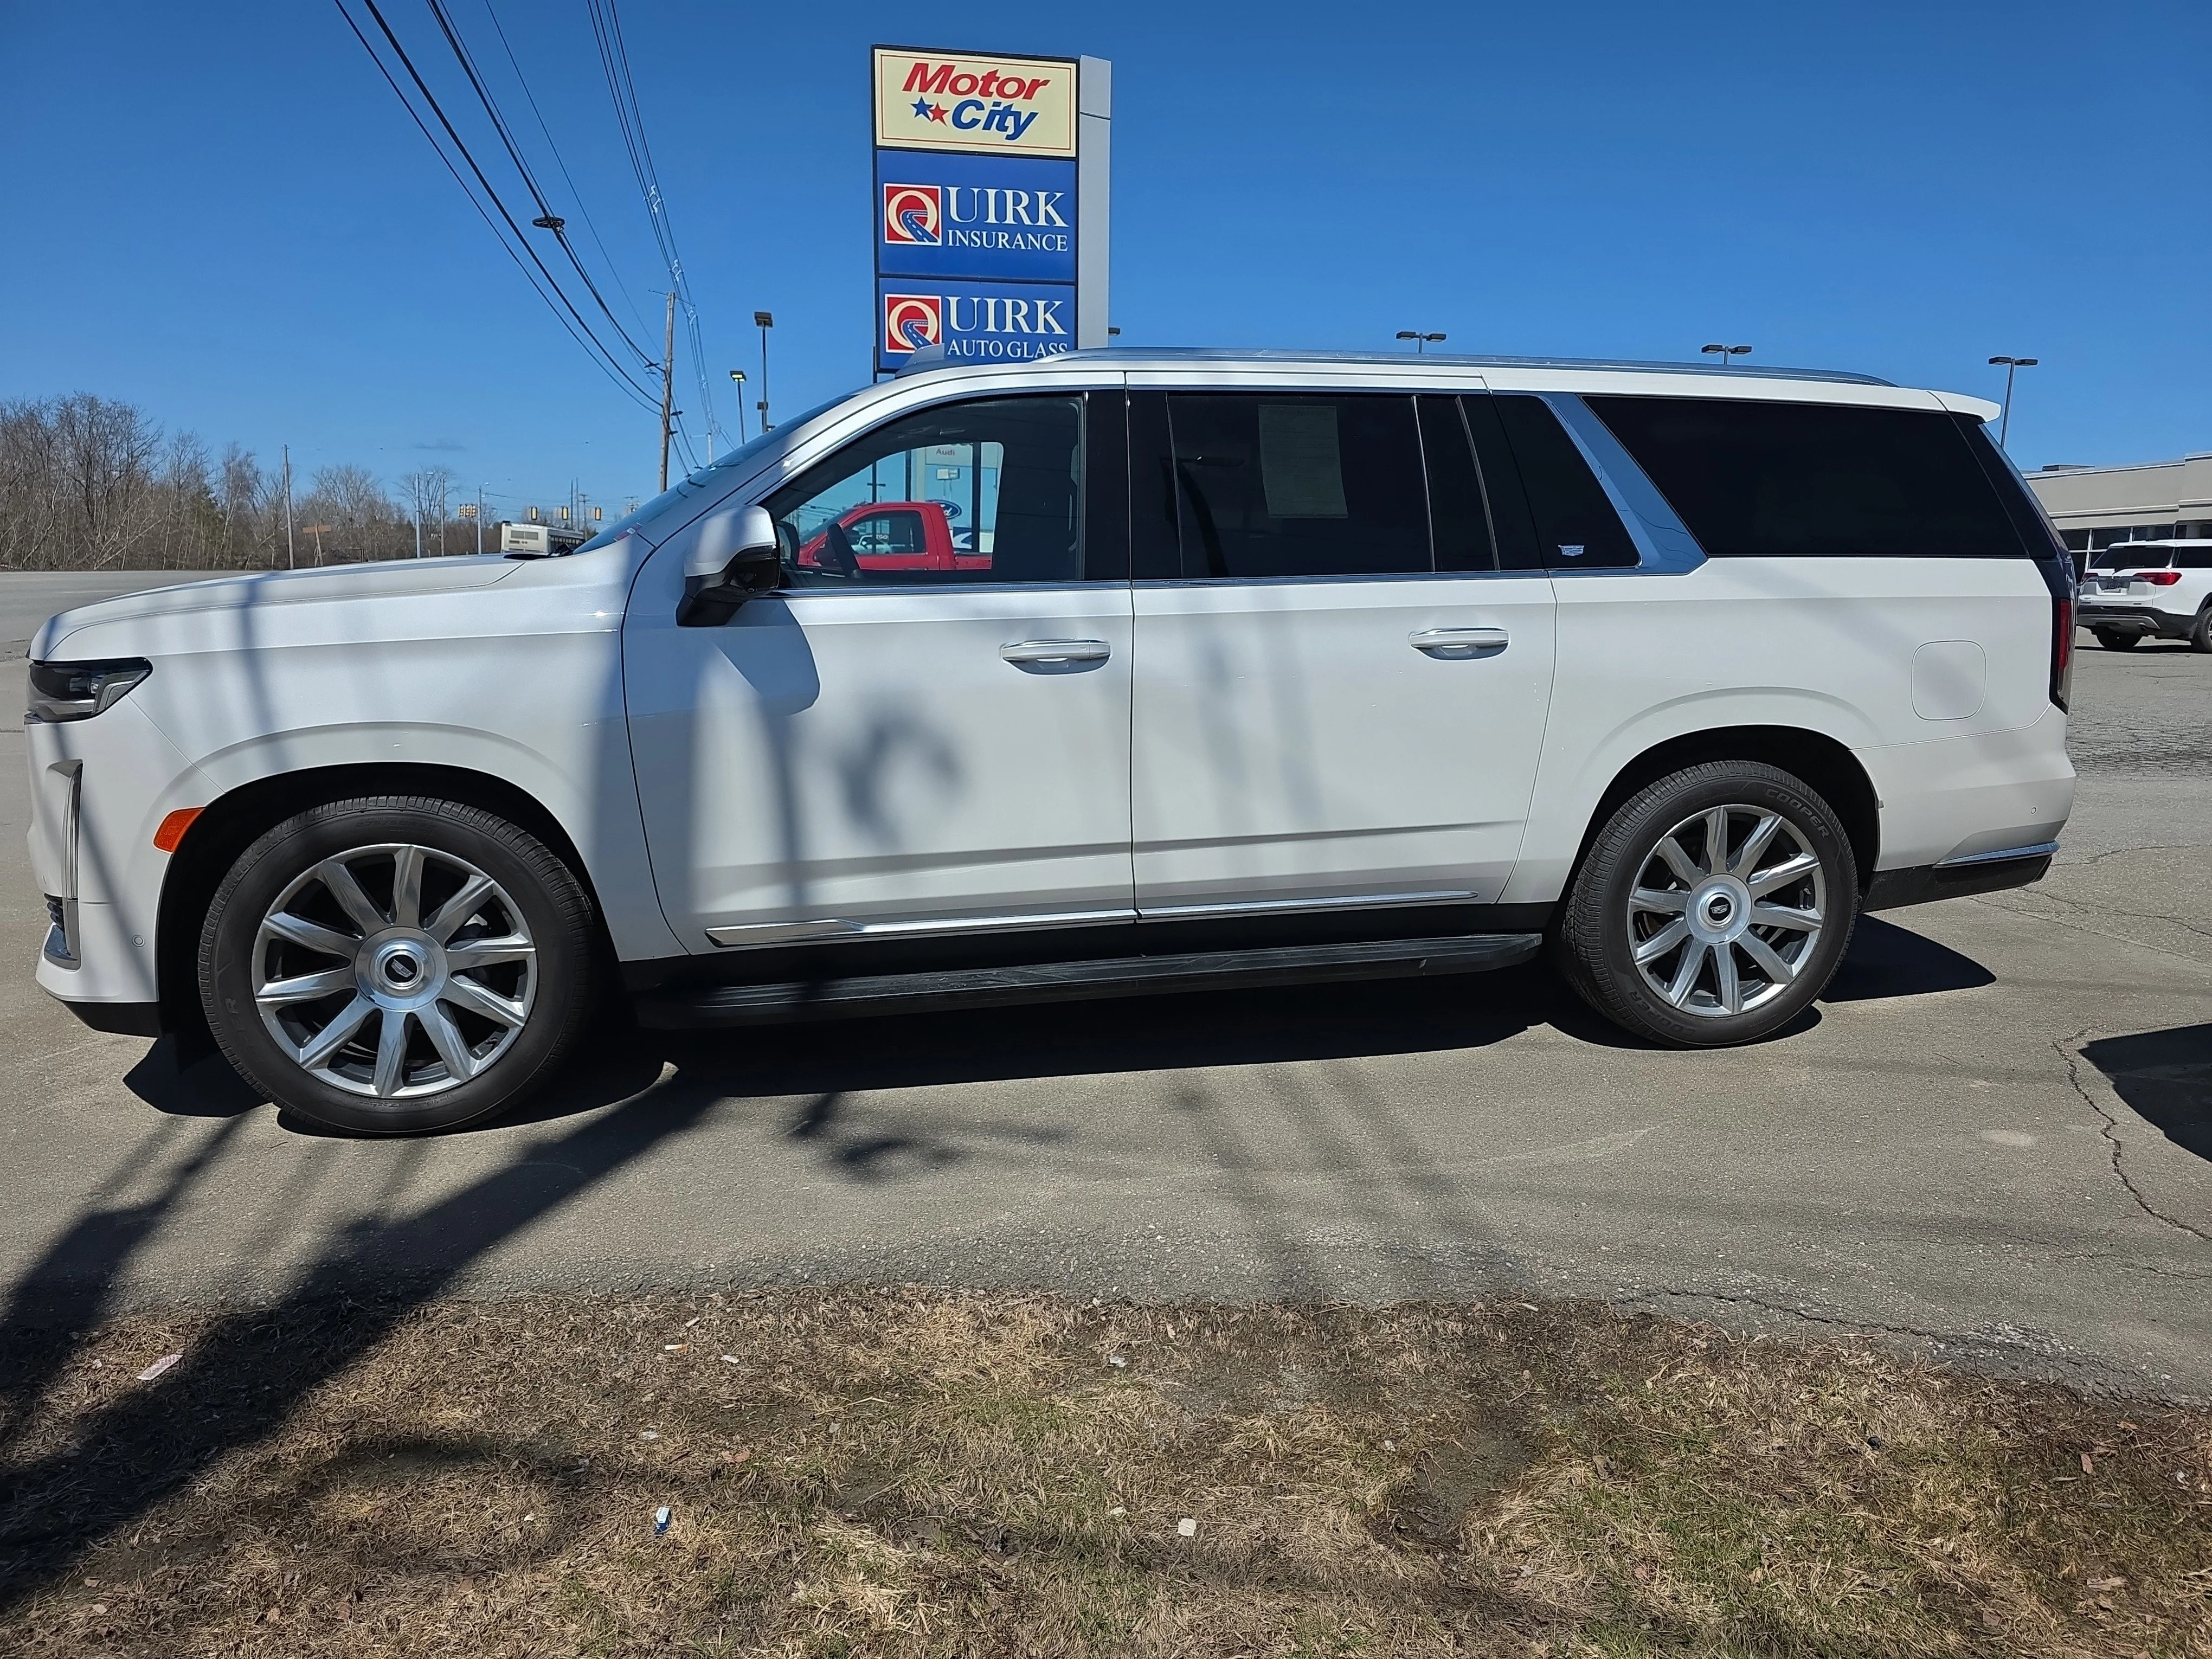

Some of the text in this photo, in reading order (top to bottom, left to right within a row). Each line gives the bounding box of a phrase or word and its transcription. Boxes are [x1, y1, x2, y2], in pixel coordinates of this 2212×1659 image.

[903, 62, 1050, 100] Motor
[952, 100, 1039, 140] City
[947, 229, 1068, 252] INSURANCE
[947, 339, 1068, 358] AUTO GLASS
[1765, 788, 1830, 839] COOPER
[1628, 990, 1697, 1038] COOPER
